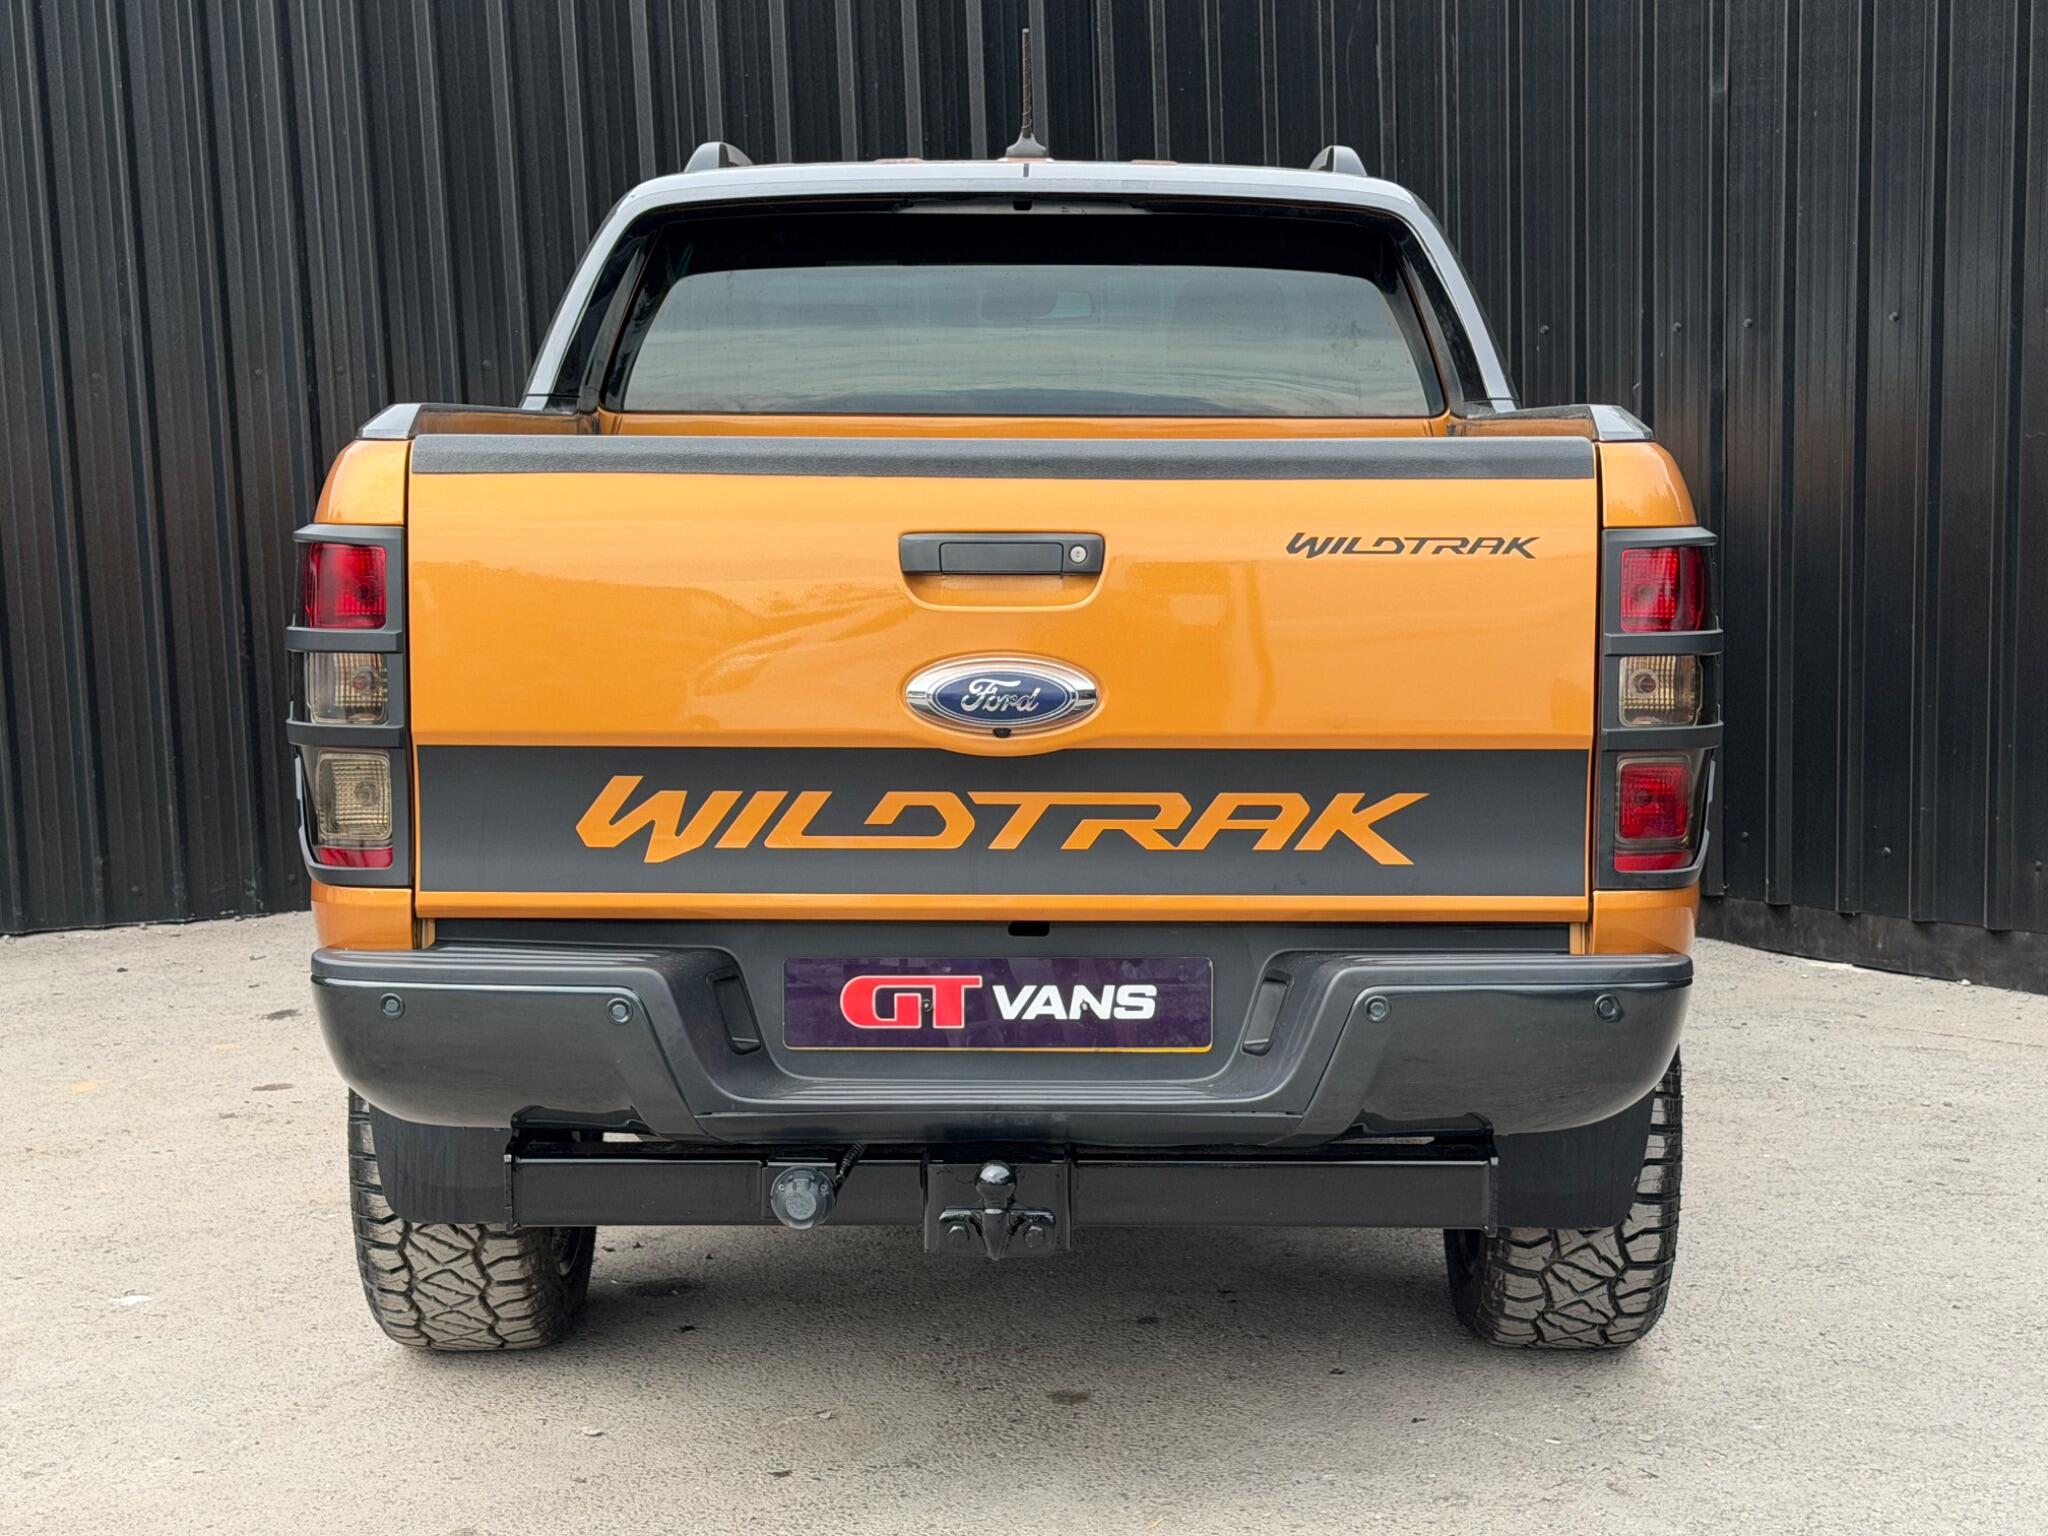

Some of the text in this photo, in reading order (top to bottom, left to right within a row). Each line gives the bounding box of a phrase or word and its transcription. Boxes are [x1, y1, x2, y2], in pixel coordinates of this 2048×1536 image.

[1286, 532, 1540, 559] WILDTRAK
[960, 677, 1041, 712] Ford
[576, 776, 1428, 866] WILDTRAK
[840, 976, 1159, 1029] GT VANS
